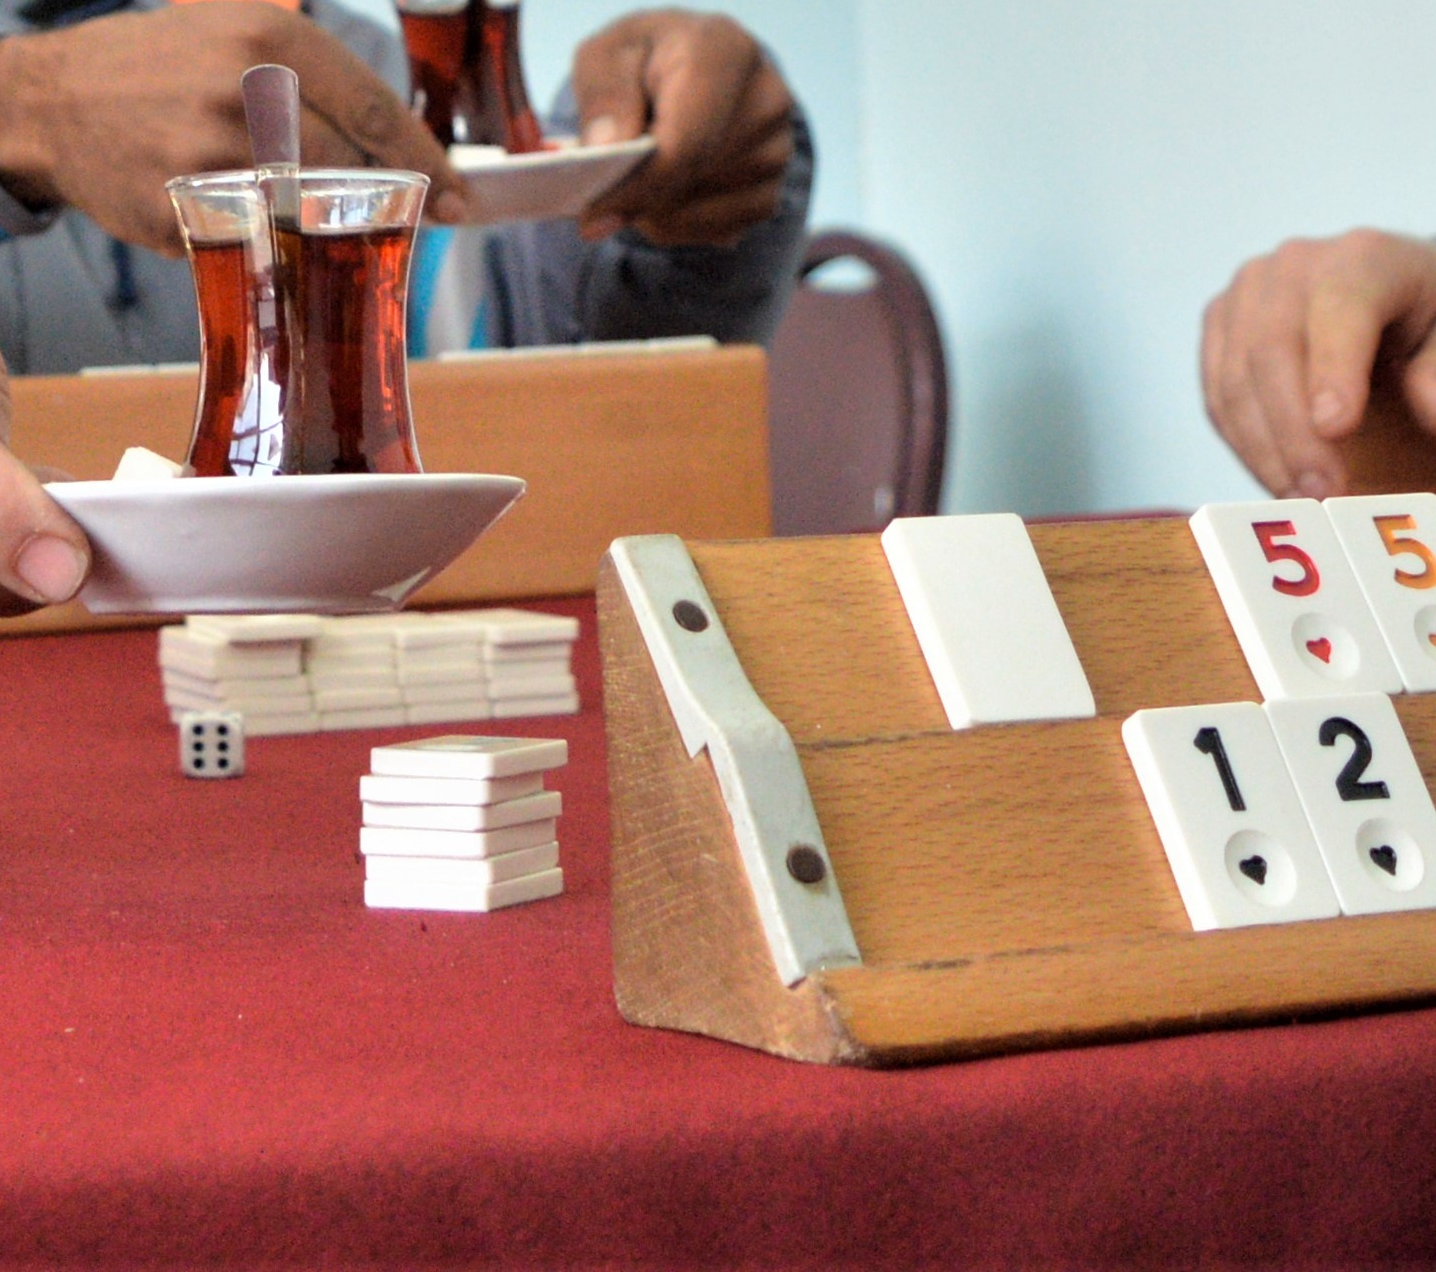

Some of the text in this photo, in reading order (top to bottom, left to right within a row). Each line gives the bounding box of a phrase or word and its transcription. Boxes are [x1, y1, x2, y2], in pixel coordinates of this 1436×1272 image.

[1250, 520, 1321, 597] 5
[1193, 716, 1391, 812] 1 2
